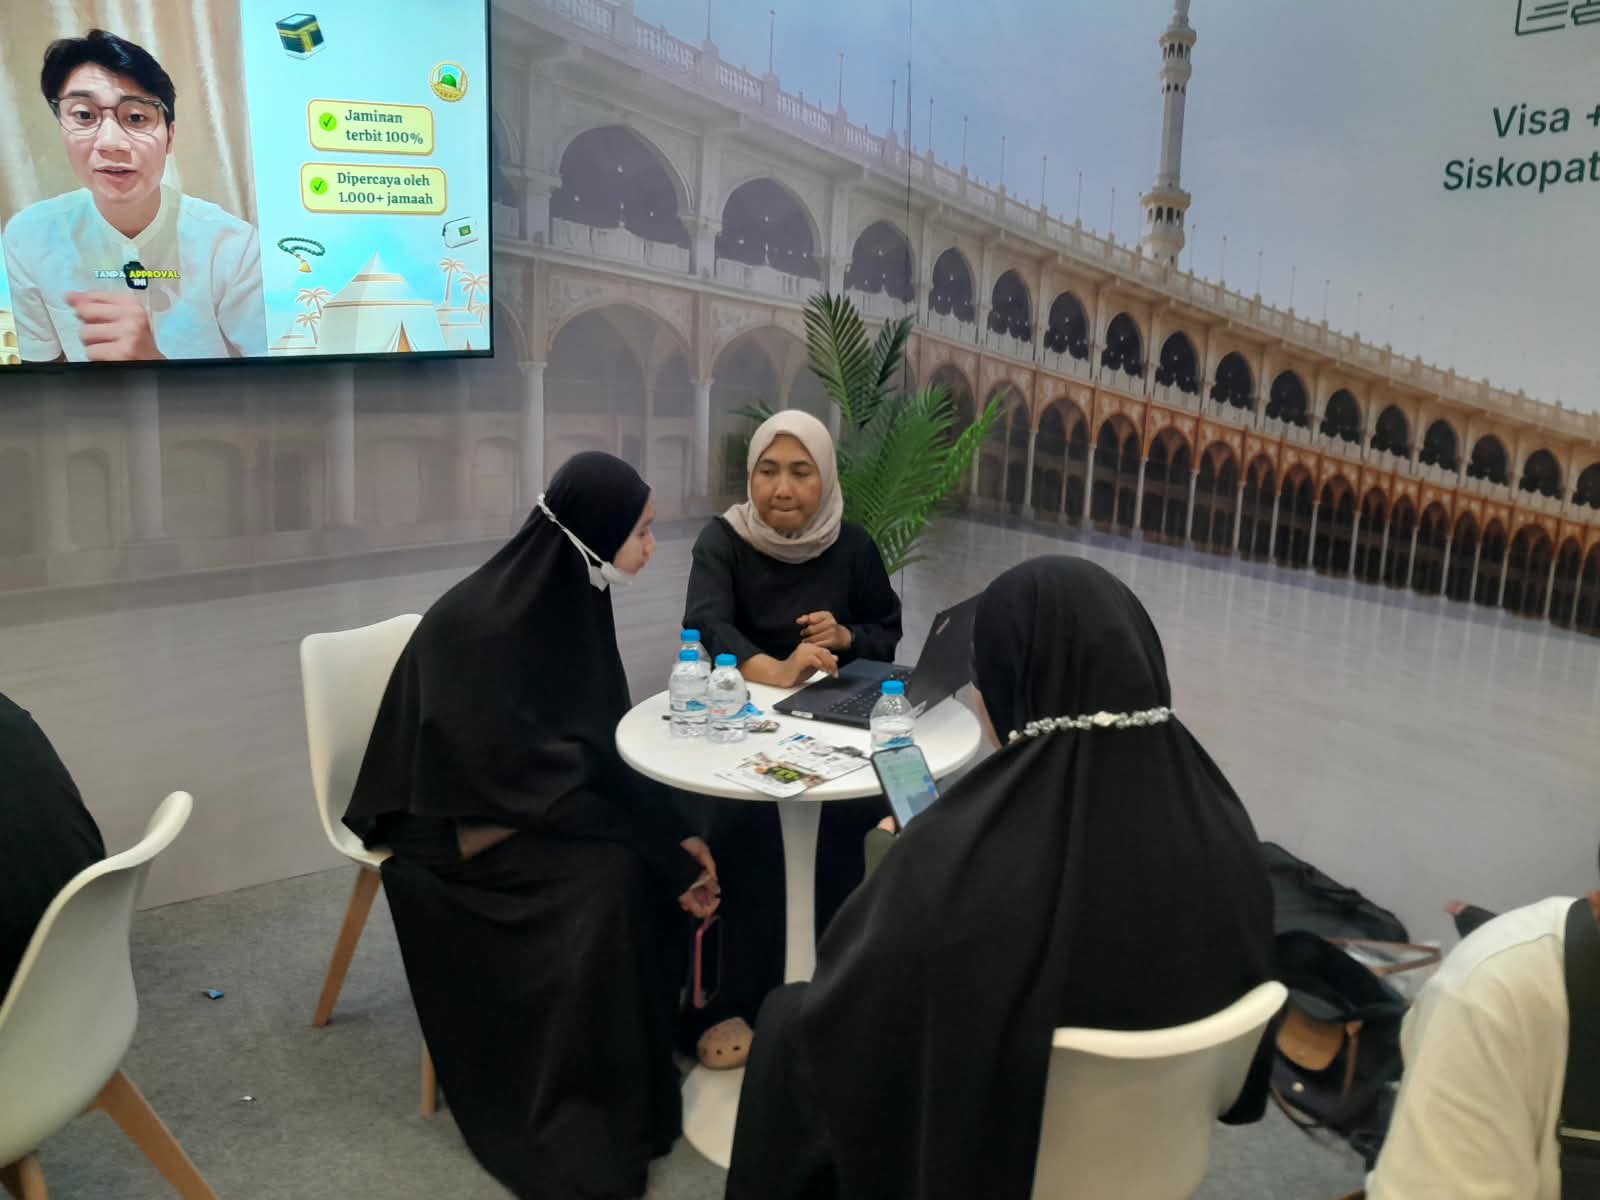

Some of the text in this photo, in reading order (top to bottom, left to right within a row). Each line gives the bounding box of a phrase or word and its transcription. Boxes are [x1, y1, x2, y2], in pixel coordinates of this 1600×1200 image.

[345, 109, 403, 124] Jaminan
[1492, 103, 1570, 138] Visa
[346, 129, 424, 145] terbit 100%
[337, 172, 431, 188] Dipercaya oleh
[338, 191, 433, 206] 1.000+ jamaah
[129, 270, 181, 279] APPROVAL
